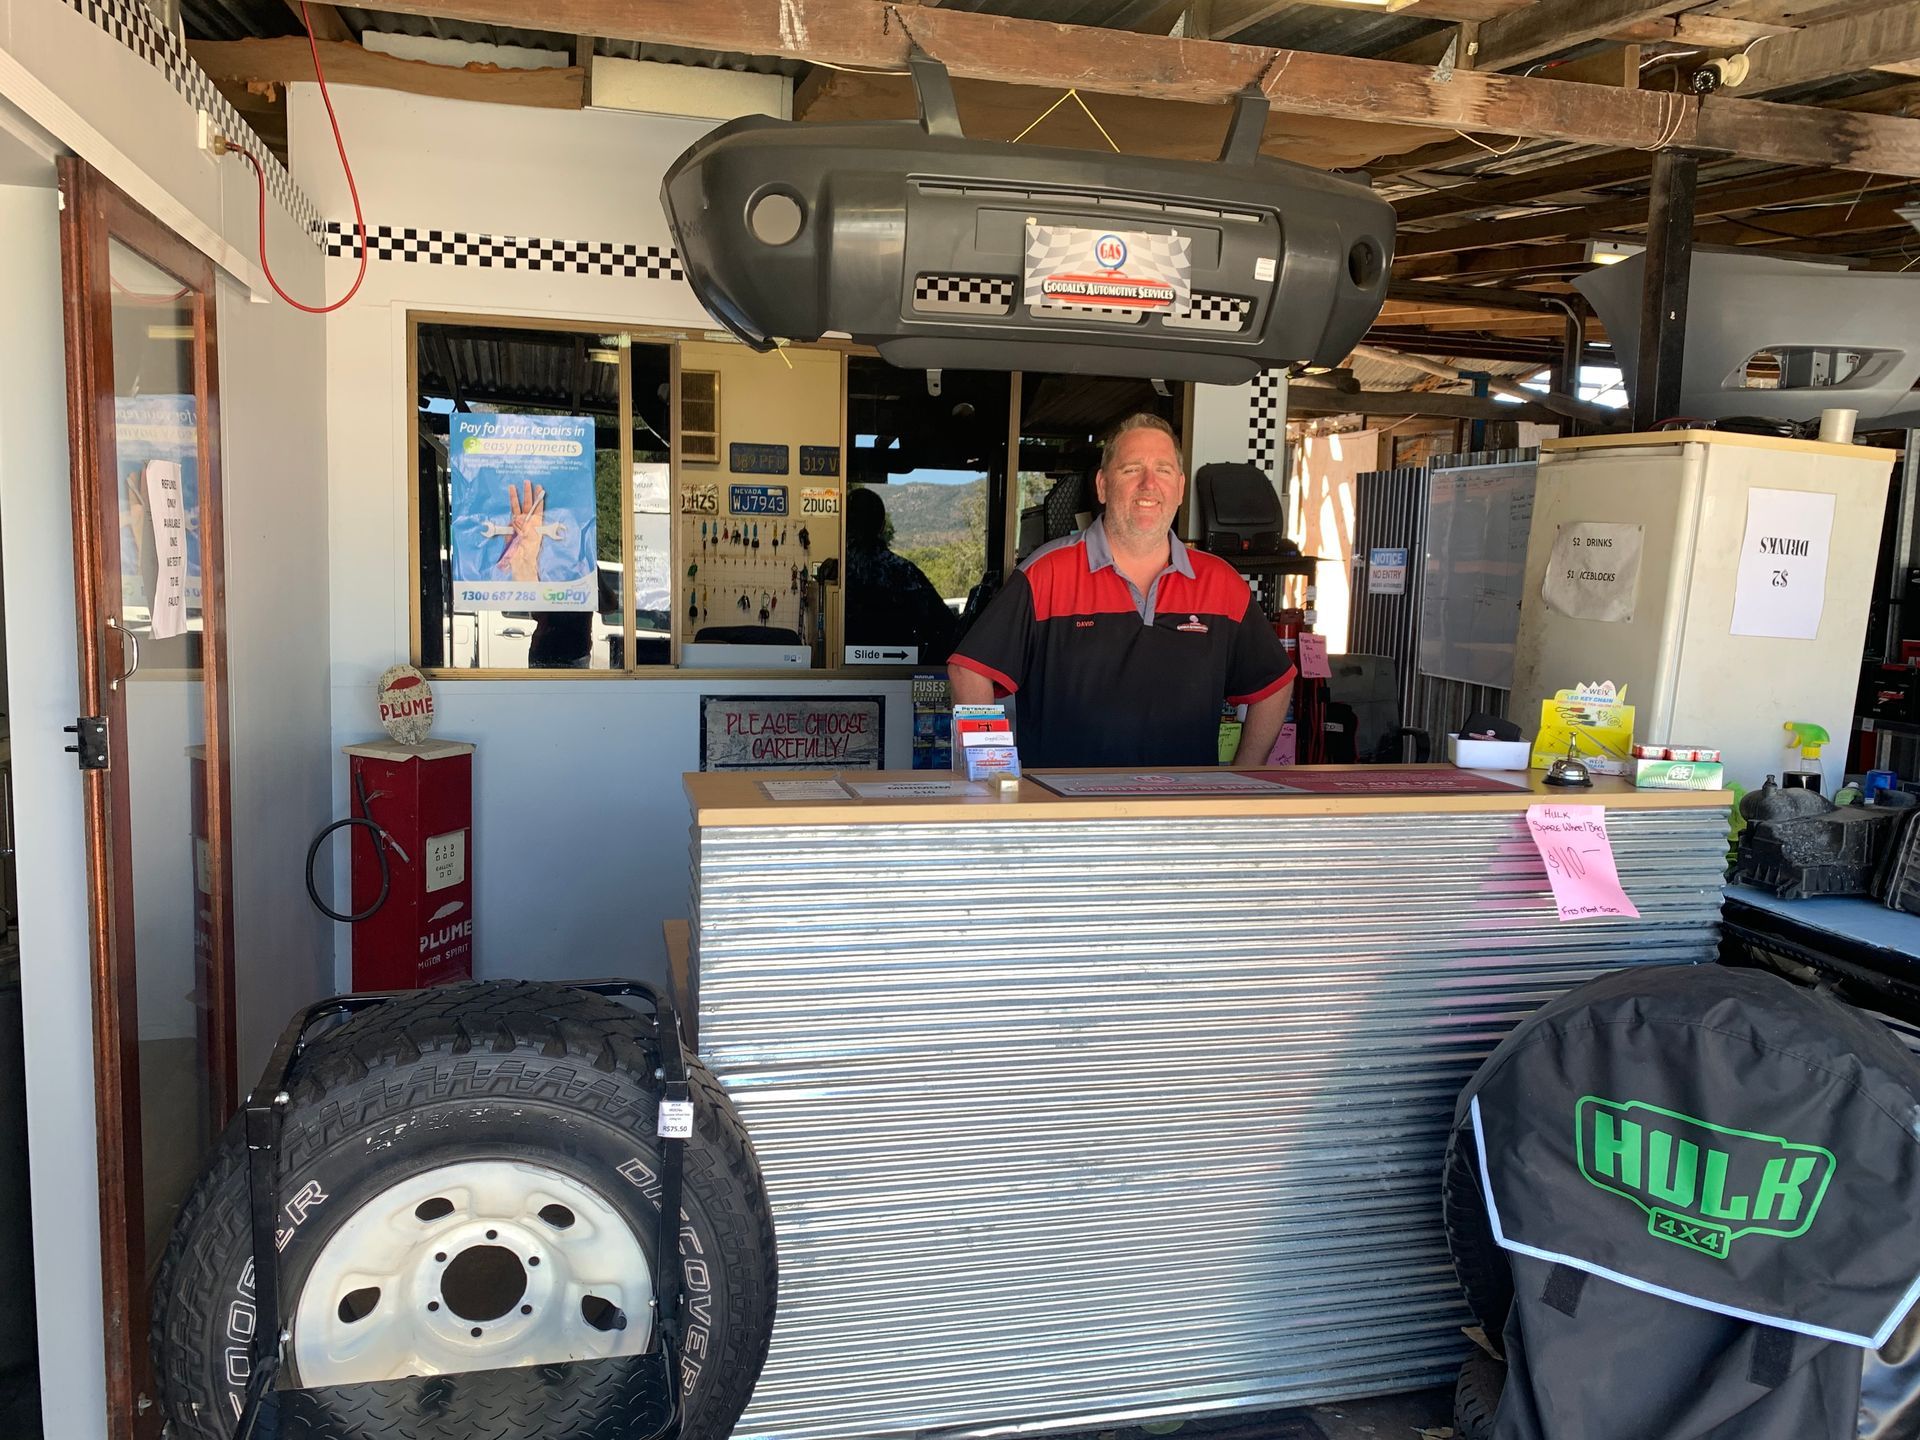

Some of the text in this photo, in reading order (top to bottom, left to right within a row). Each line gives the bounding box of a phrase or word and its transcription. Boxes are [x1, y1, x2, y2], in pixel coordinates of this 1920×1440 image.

[1100, 243, 1121, 260] GAS
[1043, 281, 1174, 300] GOODALL'S AUTOMOTIVE SERVICES
[460, 422, 585, 437] Pay for your repairs in
[483, 441, 512, 455] easy
[514, 442, 577, 456] payments
[803, 457, 825, 472] 319
[732, 495, 785, 512] WJ7943
[803, 498, 839, 513] 2DUG1
[1573, 537, 1613, 547] $2 DRINKS
[1760, 537, 1809, 557] DRINKS
[1375, 552, 1403, 564] NOTICE
[1373, 569, 1402, 579] NO ENTRY
[1567, 569, 1616, 581] $1 ICEBLOCKS
[1772, 570, 1788, 588] $2
[461, 591, 537, 601] 1300 687 288
[543, 588, 591, 604] GoPay
[854, 649, 880, 659] Slide
[914, 681, 945, 692] FUSES
[380, 697, 434, 721] PLUME
[725, 712, 868, 736] PLEASE CHOOSE
[752, 733, 850, 759] CAREFULLY!
[420, 920, 472, 953] PLUME
[418, 943, 469, 970] MOTOR SPIRIT
[1595, 1110, 1817, 1221] HULK
